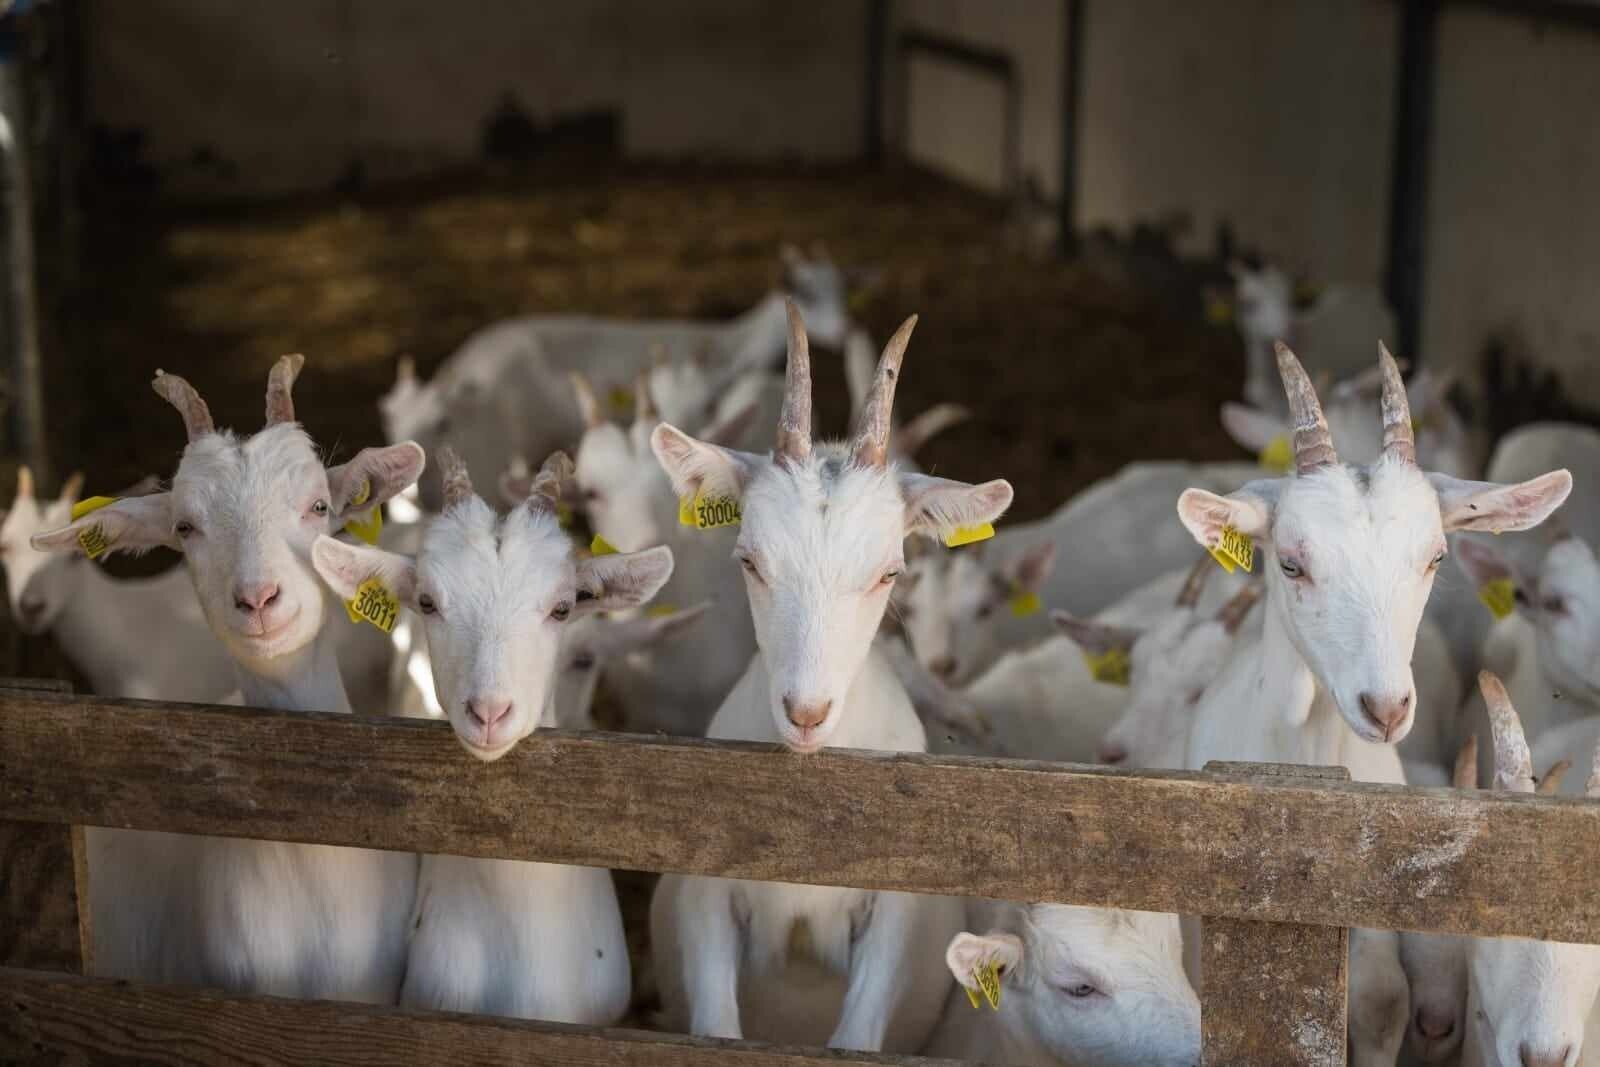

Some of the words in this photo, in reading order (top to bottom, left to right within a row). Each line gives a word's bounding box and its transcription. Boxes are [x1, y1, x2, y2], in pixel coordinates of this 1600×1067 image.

[697, 503, 742, 528] 30004
[1222, 530, 1251, 568] 30433
[355, 591, 396, 631] 30011
